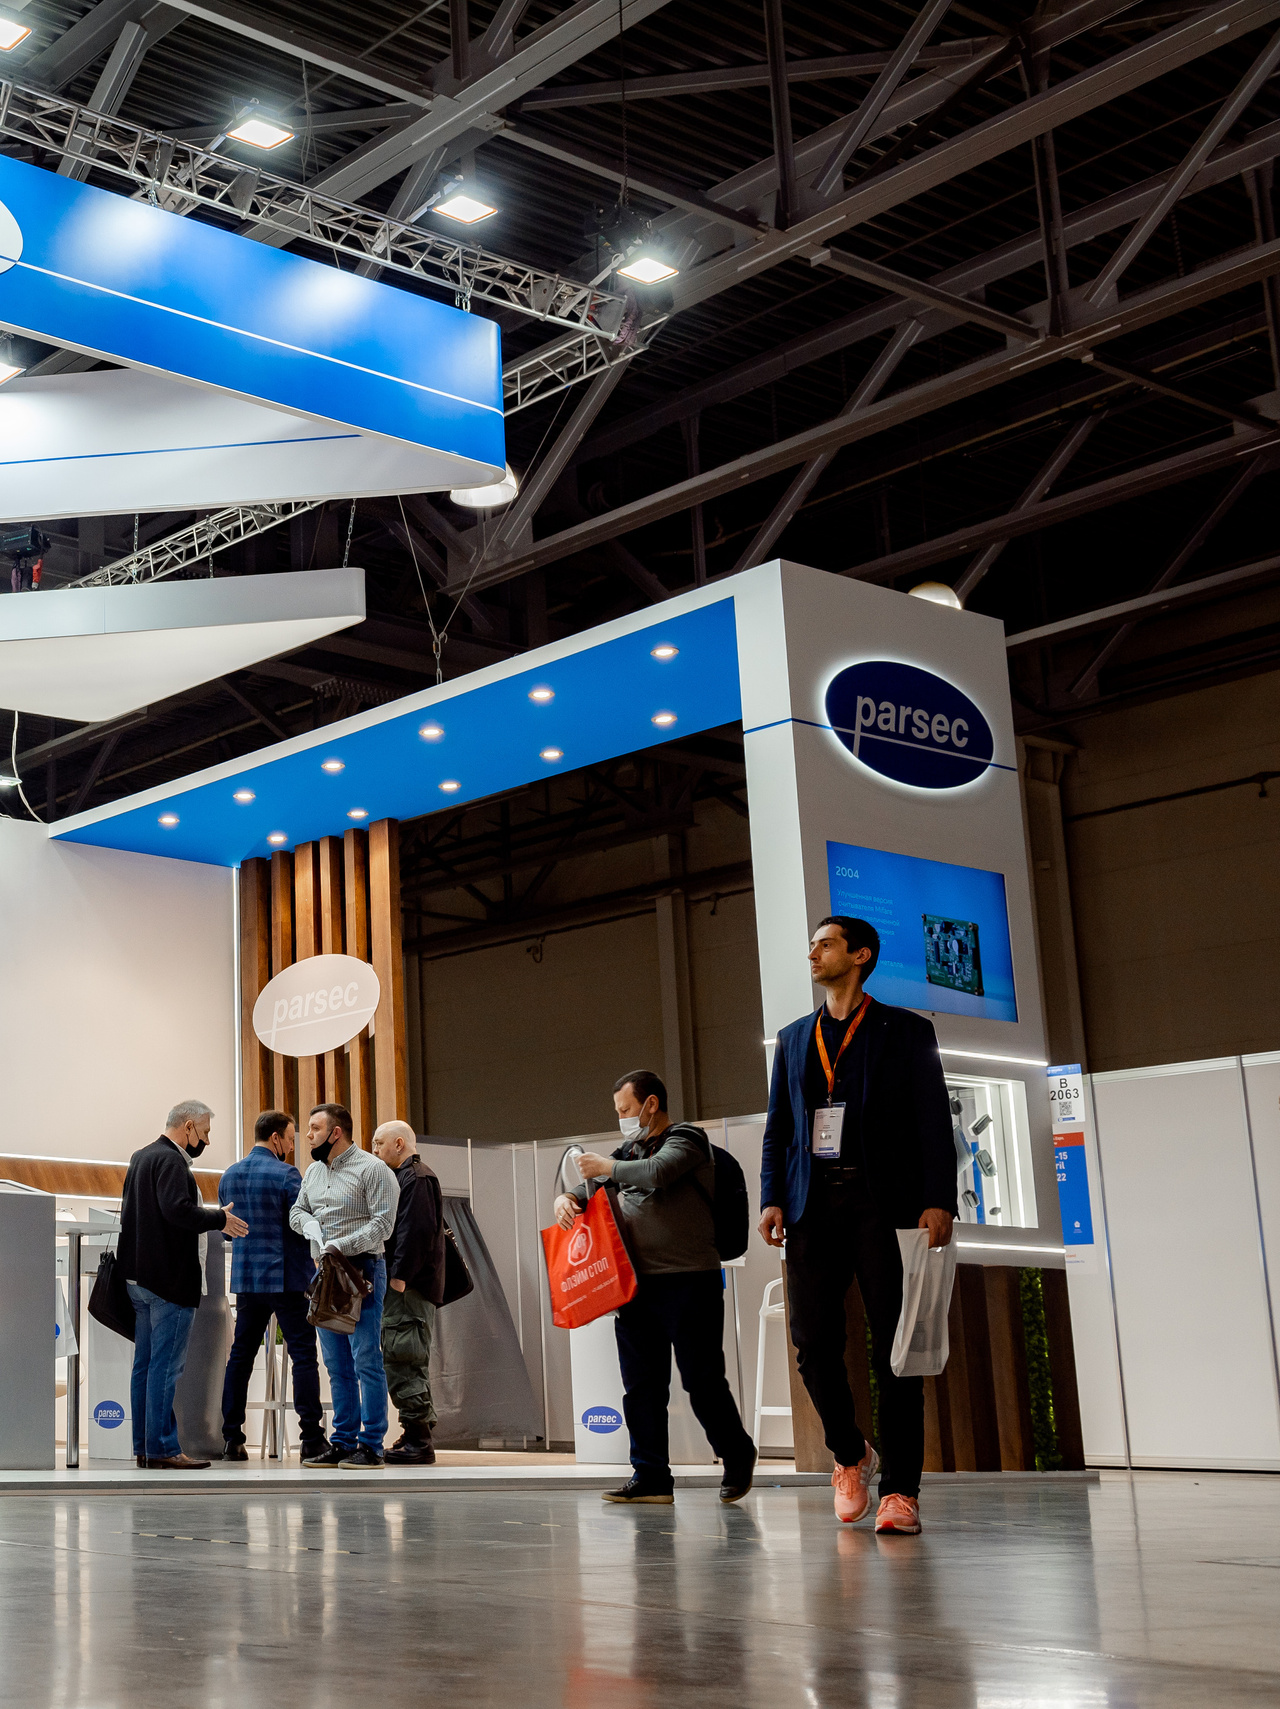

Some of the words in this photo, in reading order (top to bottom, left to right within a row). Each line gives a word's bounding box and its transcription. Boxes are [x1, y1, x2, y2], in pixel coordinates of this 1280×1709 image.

[853, 695, 969, 758] parsec
[835, 866, 859, 879] 2004
[271, 981, 359, 1050] parsec
[1059, 1078, 1068, 1089] B
[1050, 1088, 1080, 1101] 2063
[1054, 1151, 1068, 1161] -15
[1055, 1161, 1065, 1171] ril
[1056, 1172, 1067, 1182] 22
[589, 1257, 609, 1279] СТОП
[97, 1408, 120, 1425] parsec
[587, 1414, 617, 1430] parsec
